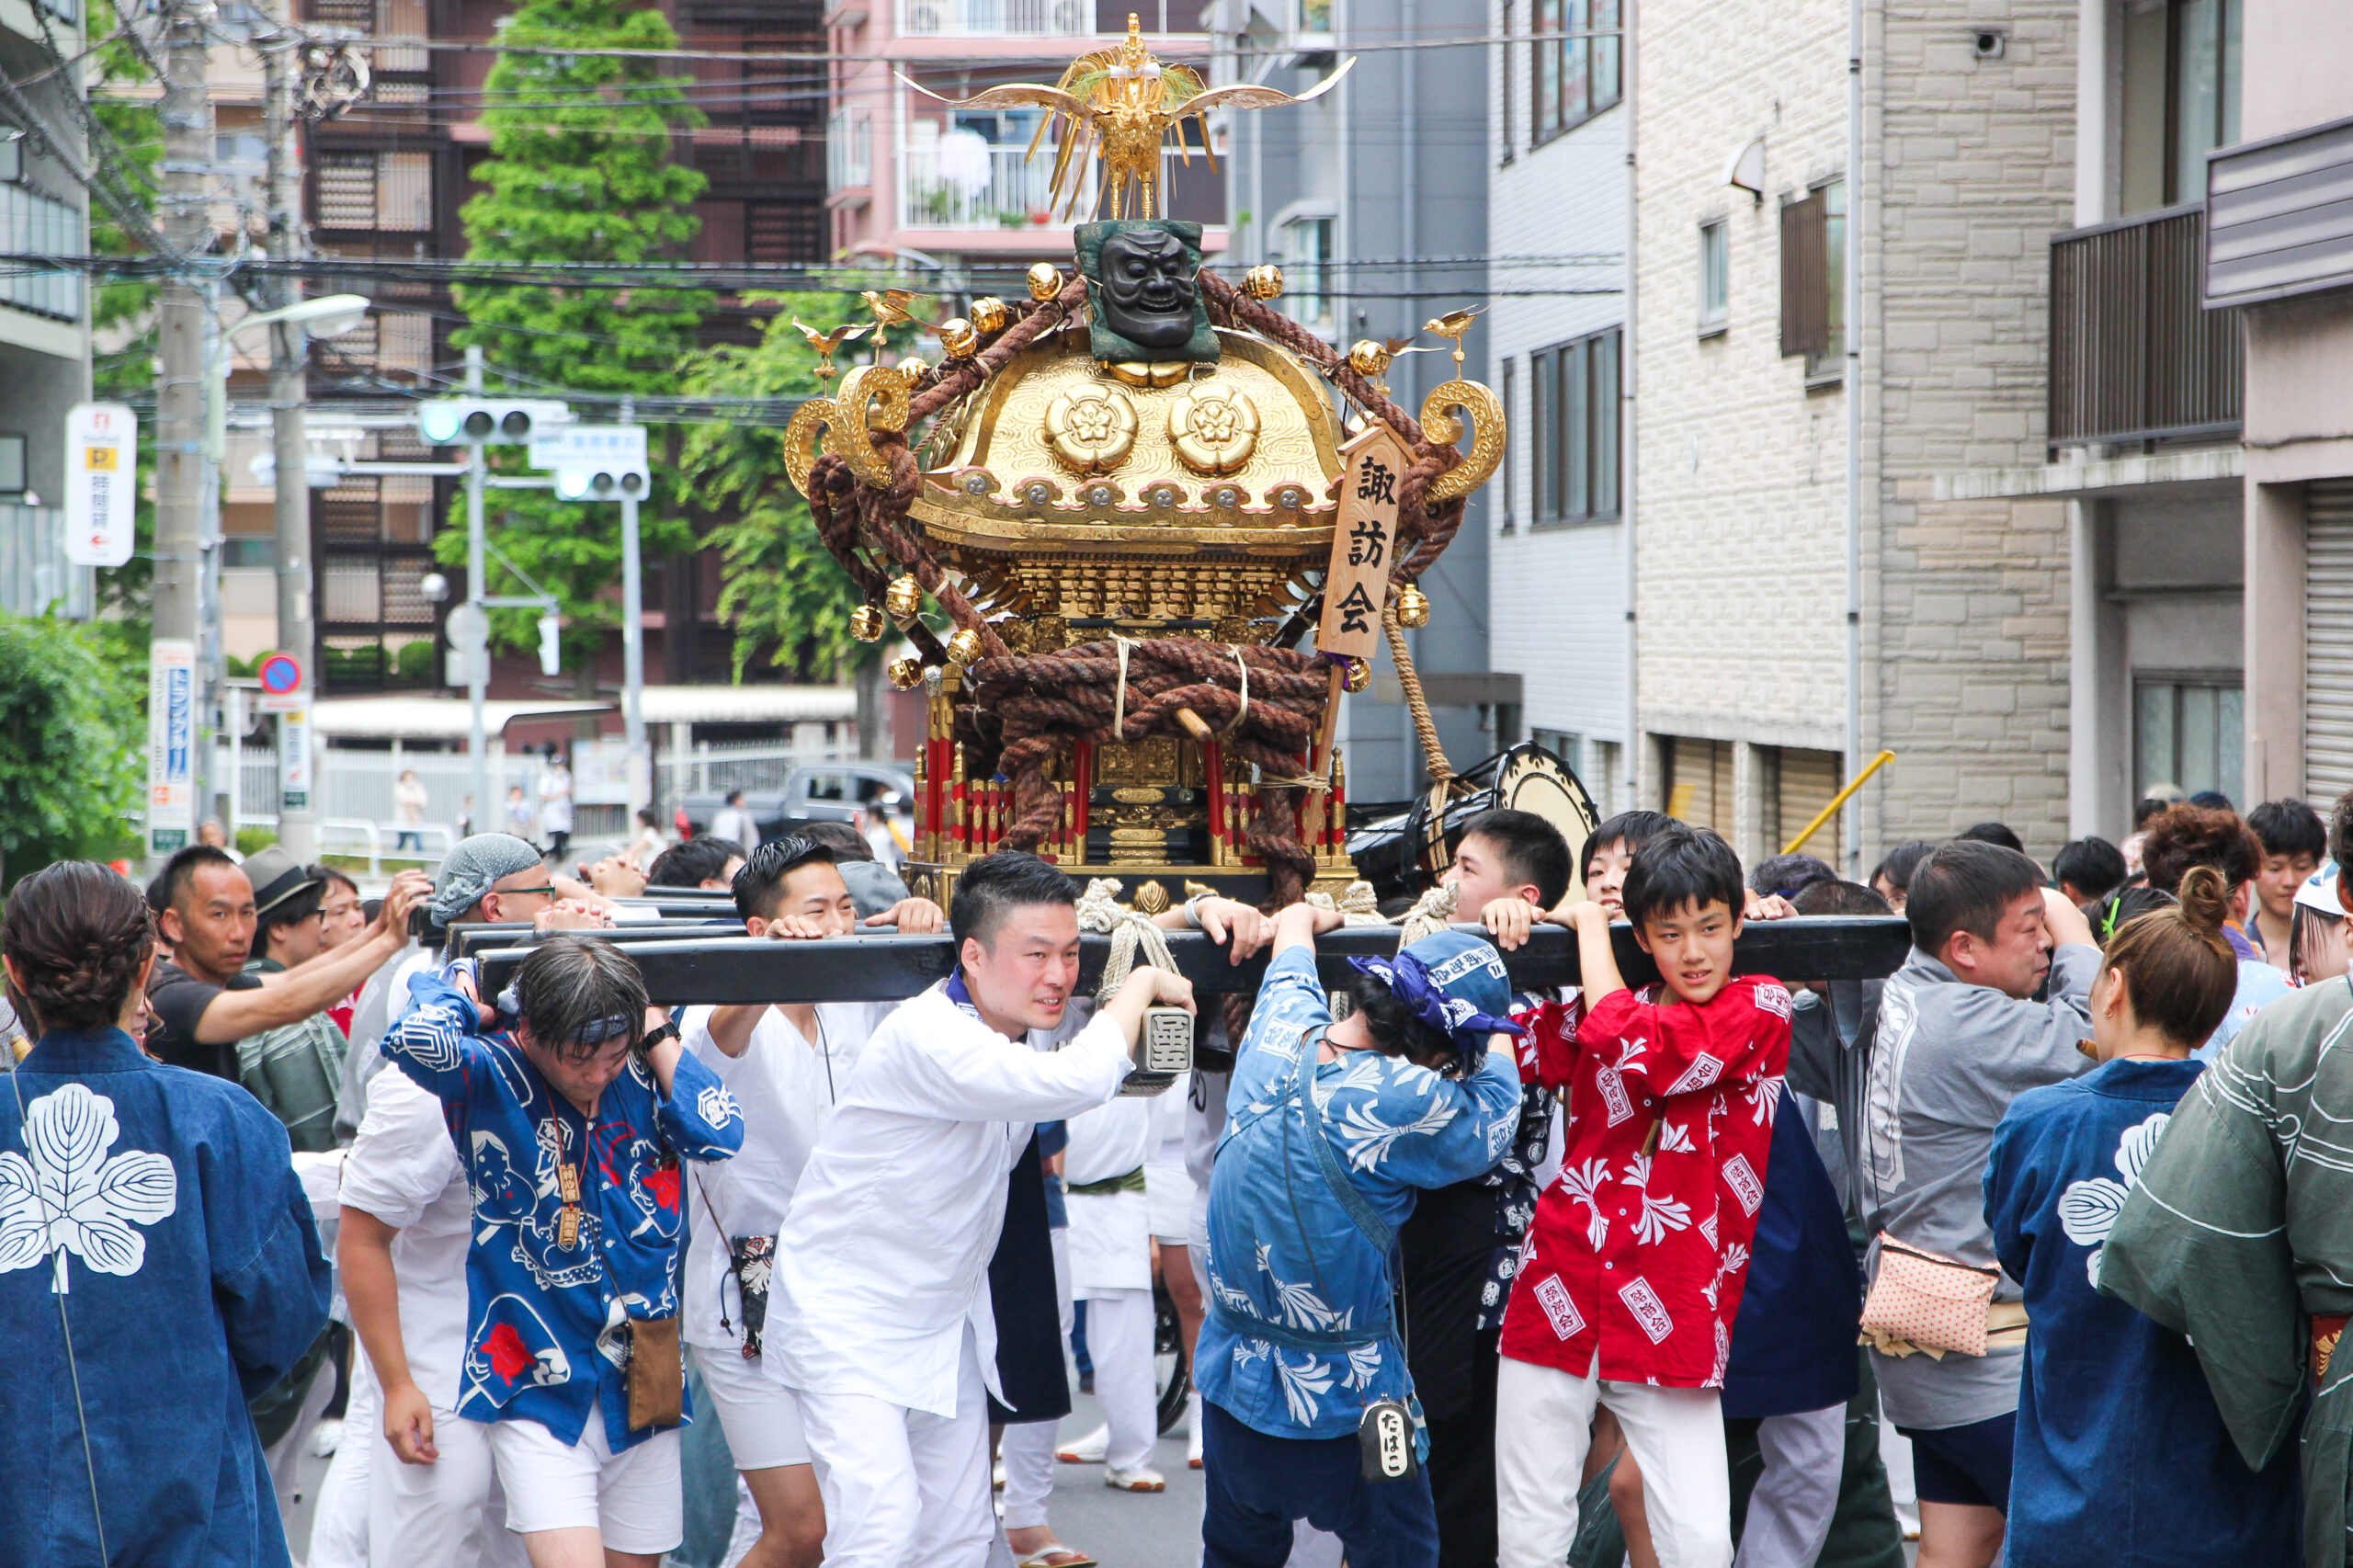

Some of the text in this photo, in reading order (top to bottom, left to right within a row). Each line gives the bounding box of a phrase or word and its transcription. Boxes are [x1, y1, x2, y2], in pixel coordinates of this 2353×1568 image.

[1336, 456, 1397, 634] 諏訪会
[1381, 1414, 1401, 1471] たばこ
